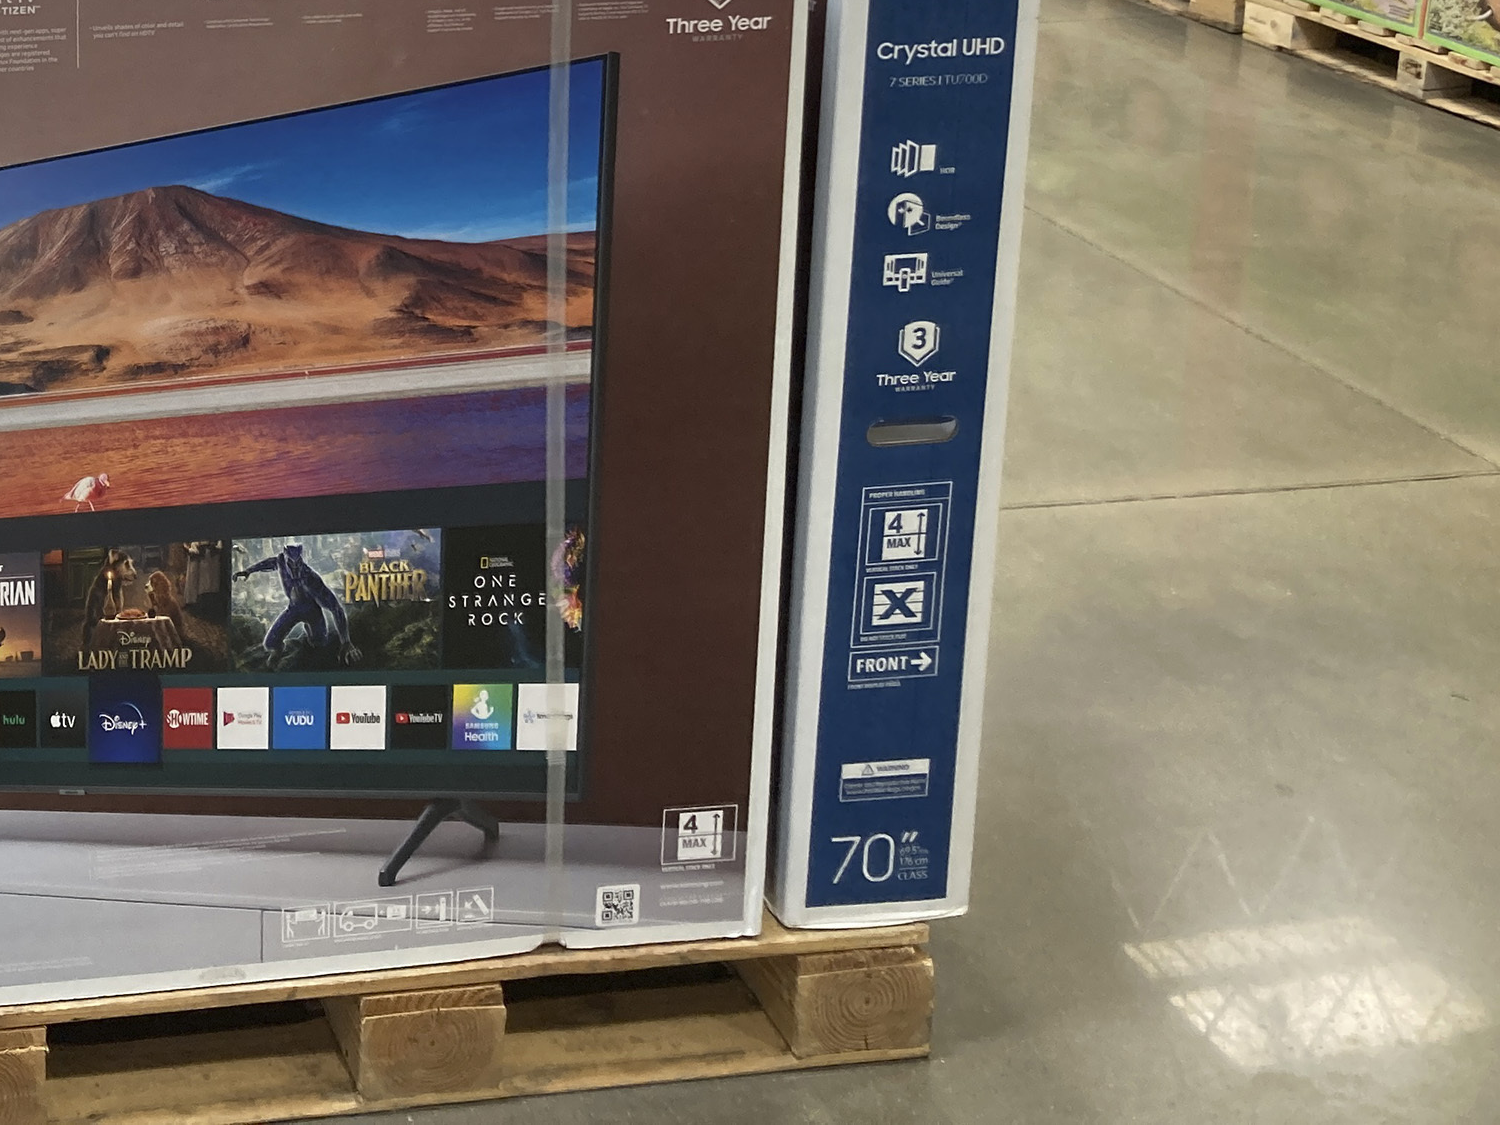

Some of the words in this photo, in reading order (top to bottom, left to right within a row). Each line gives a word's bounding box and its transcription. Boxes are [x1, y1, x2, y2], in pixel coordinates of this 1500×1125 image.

[666, 17, 723, 35] Three
[728, 15, 772, 31] Year
[877, 39, 957, 65] Crystal
[962, 37, 1005, 57] UHD
[876, 371, 920, 387] Three
[923, 369, 956, 383] Year
[886, 537, 912, 549] MAX
[359, 559, 410, 574] BLACK
[344, 569, 428, 608] PANTHER
[473, 574, 517, 590] ONE
[448, 592, 546, 609] STRANGE
[467, 612, 525, 627] ROCK
[78, 649, 117, 672] LADY
[129, 646, 193, 671] TRAMP
[856, 656, 908, 673] FRONT
[3, 714, 26, 726] hulu
[284, 714, 315, 727] VUDU
[352, 712, 380, 725] YouTube
[464, 731, 499, 743] Health
